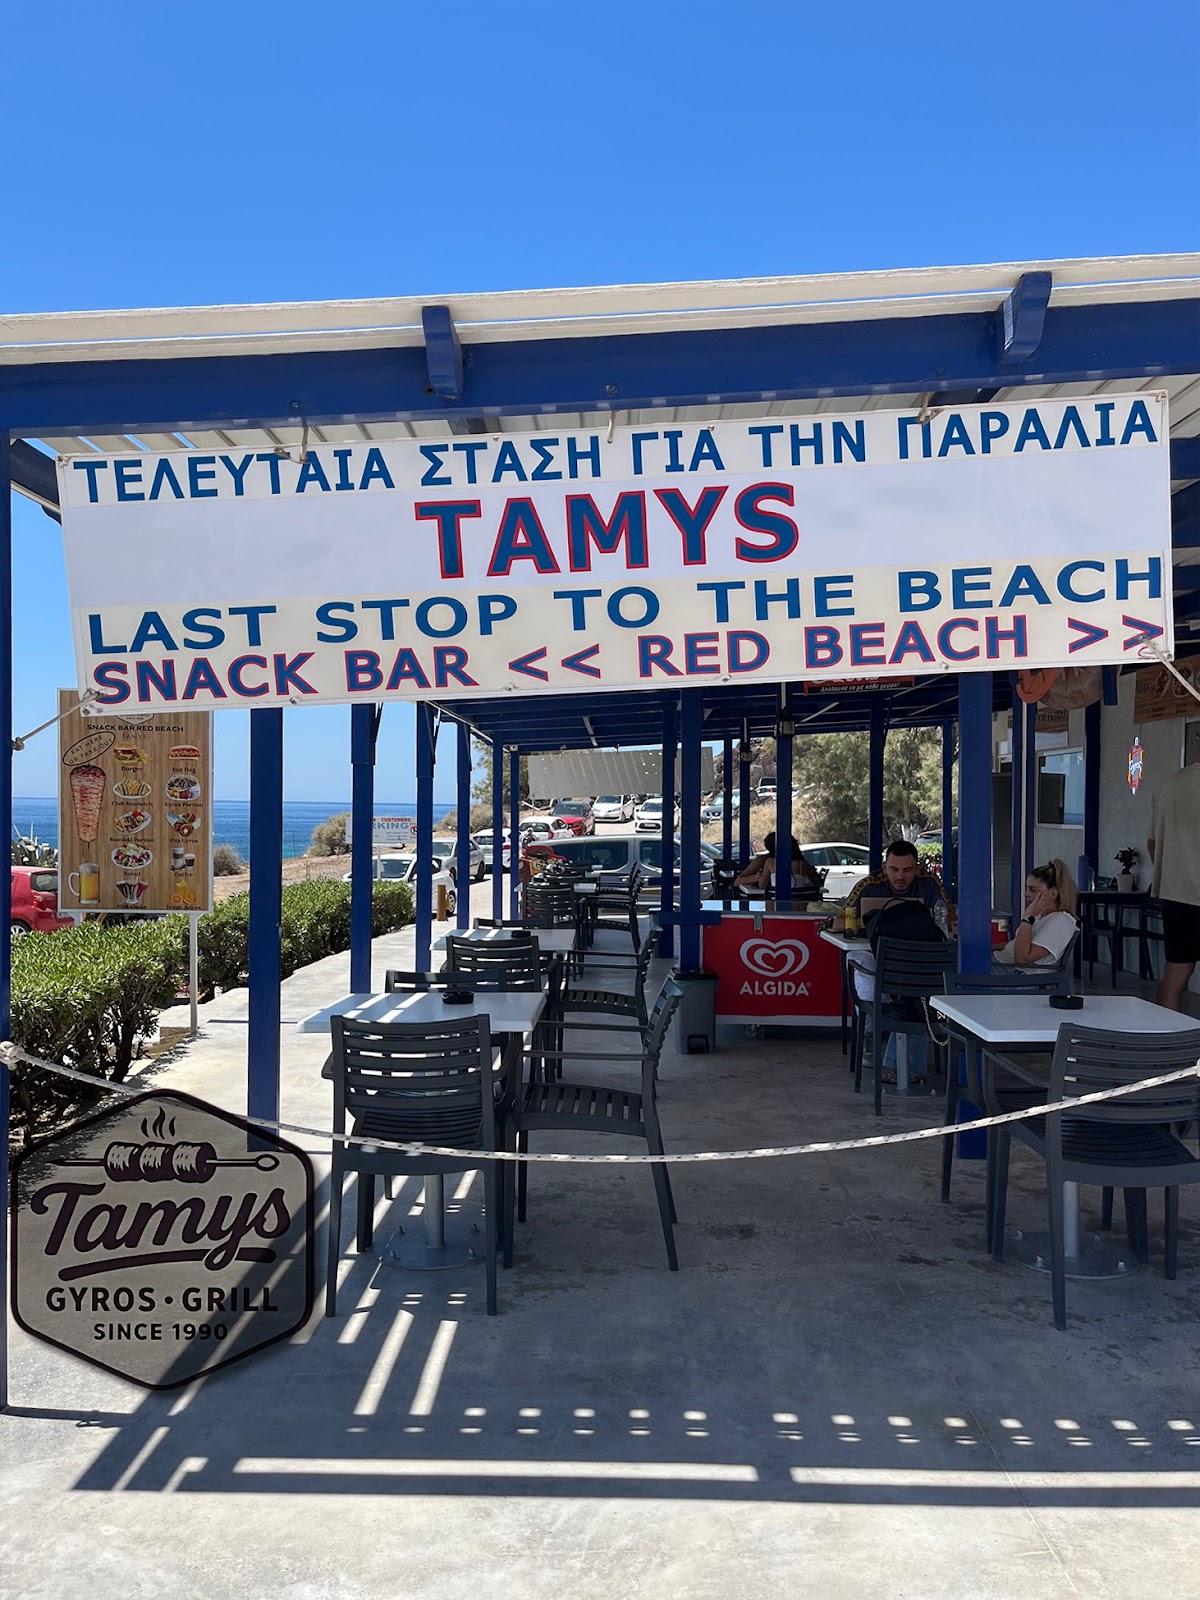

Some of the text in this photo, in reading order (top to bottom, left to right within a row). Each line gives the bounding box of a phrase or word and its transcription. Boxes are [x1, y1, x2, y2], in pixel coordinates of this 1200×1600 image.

[73, 400, 1158, 504] ΤΕΛΕΥΤΑΙΑ ΣΤΑΣΗ ΓΙΑ ΤΗΝ ΠΑΡΑΛΙΑ
[414, 482, 799, 579] TAMYS
[89, 557, 1162, 655] LAST STOP TO THE BEACH
[94, 652, 319, 705] SNACK
[345, 646, 480, 692] BAR
[638, 630, 770, 678] RED
[804, 615, 1028, 669] BEACH
[68, 738, 113, 765] OR TAKE OUT
[71, 735, 102, 755] EAT HERE
[121, 766, 143, 774] Burger
